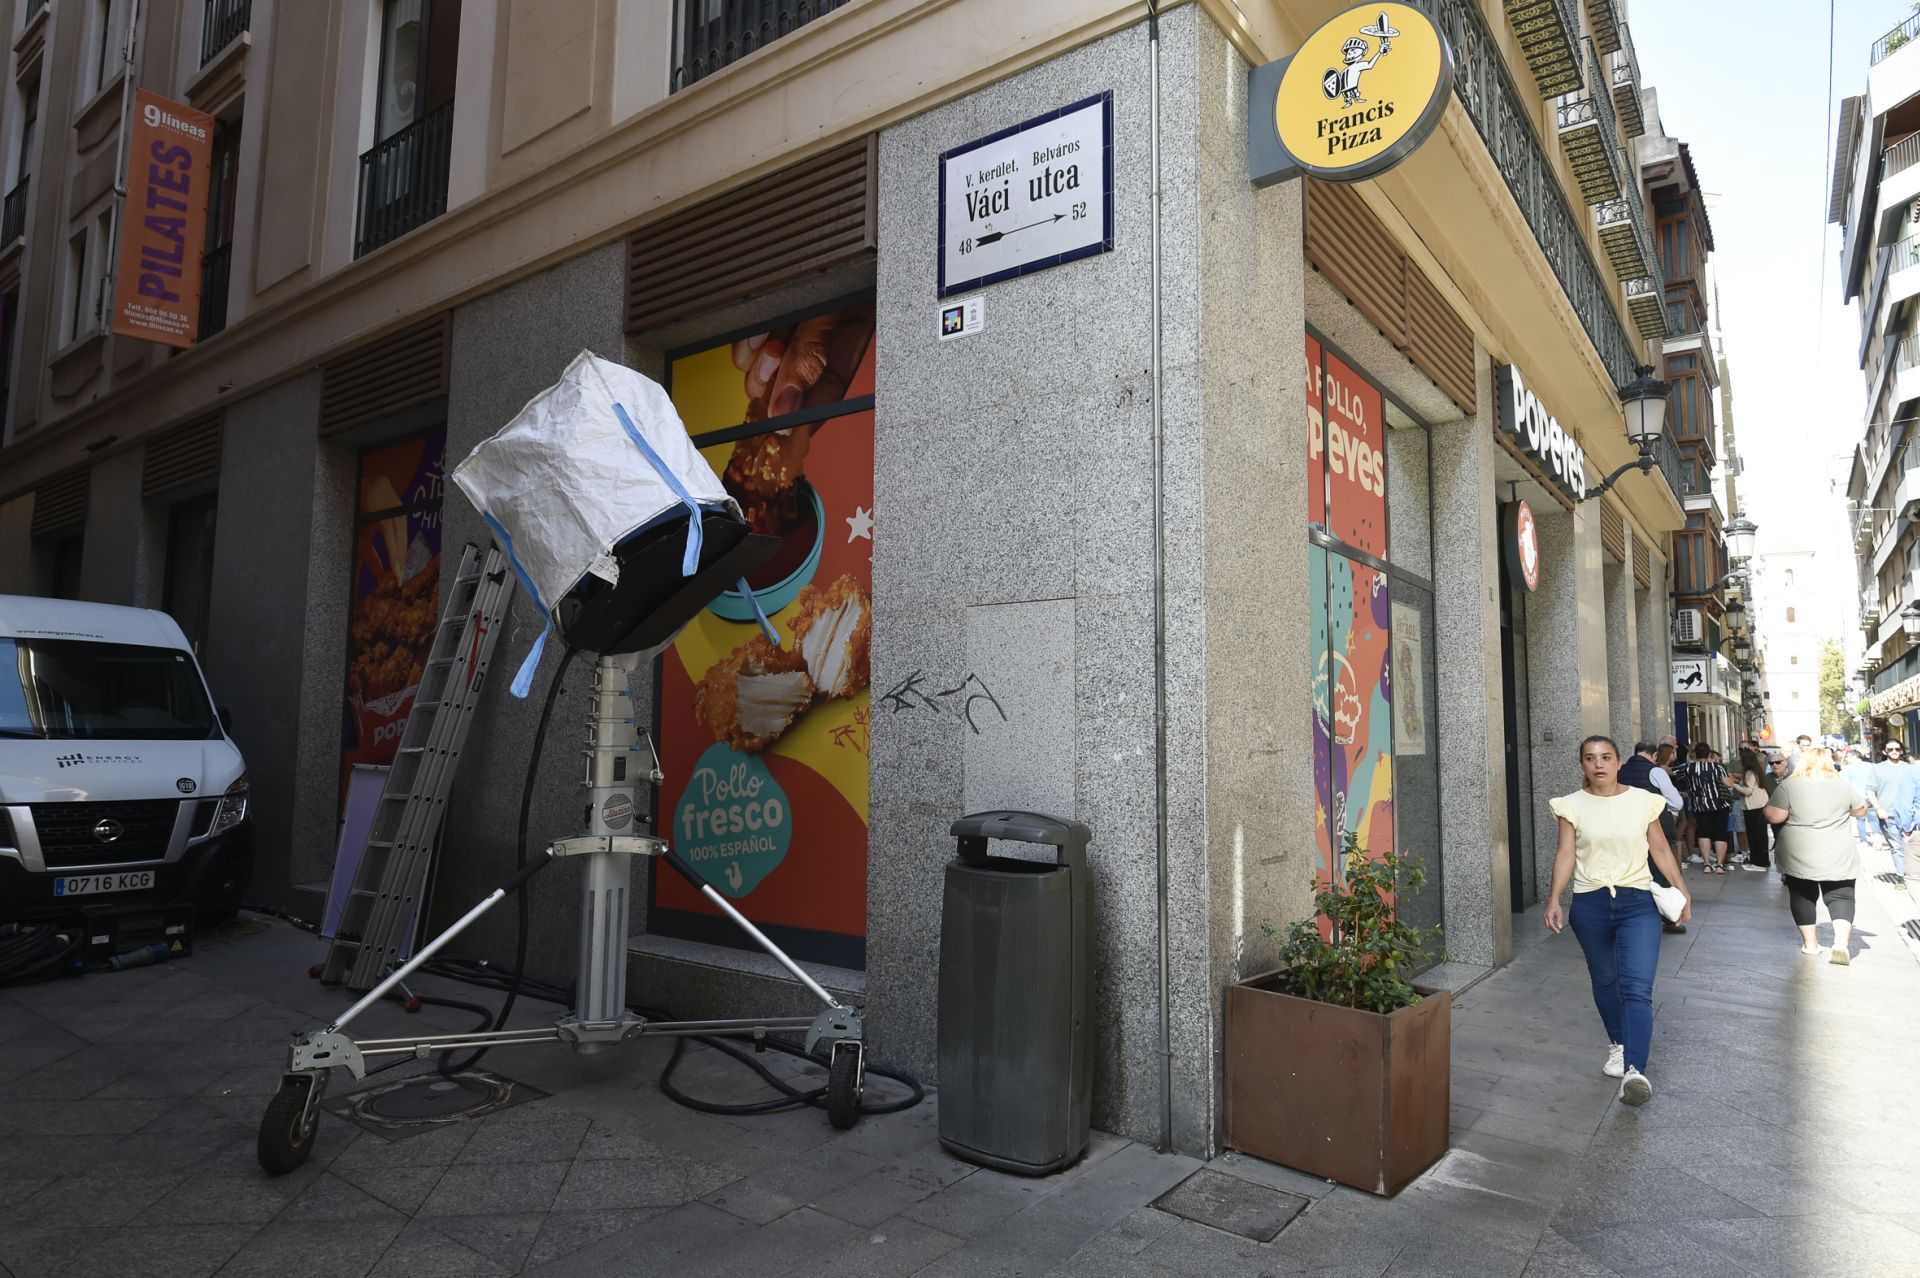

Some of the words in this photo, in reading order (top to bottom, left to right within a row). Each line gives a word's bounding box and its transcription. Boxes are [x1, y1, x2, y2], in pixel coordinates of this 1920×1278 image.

[1316, 100, 1395, 139] Francis
[1328, 126, 1382, 156] Pizza
[966, 174, 974, 188] V.
[979, 158, 1019, 184] kerület,
[1032, 140, 1080, 167] Belváros
[965, 179, 1010, 223] Váci
[1028, 164, 1080, 202] utca
[138, 140, 192, 303] PILATES
[958, 238, 972, 255] 48
[1072, 202, 1087, 221] 52
[694, 762, 764, 806] Pollo
[682, 798, 783, 840] fresco
[689, 845, 718, 861] 100%
[720, 835, 777, 857] ESPAÑOL
[68, 876, 113, 893] 0716
[118, 873, 151, 889] KCG
